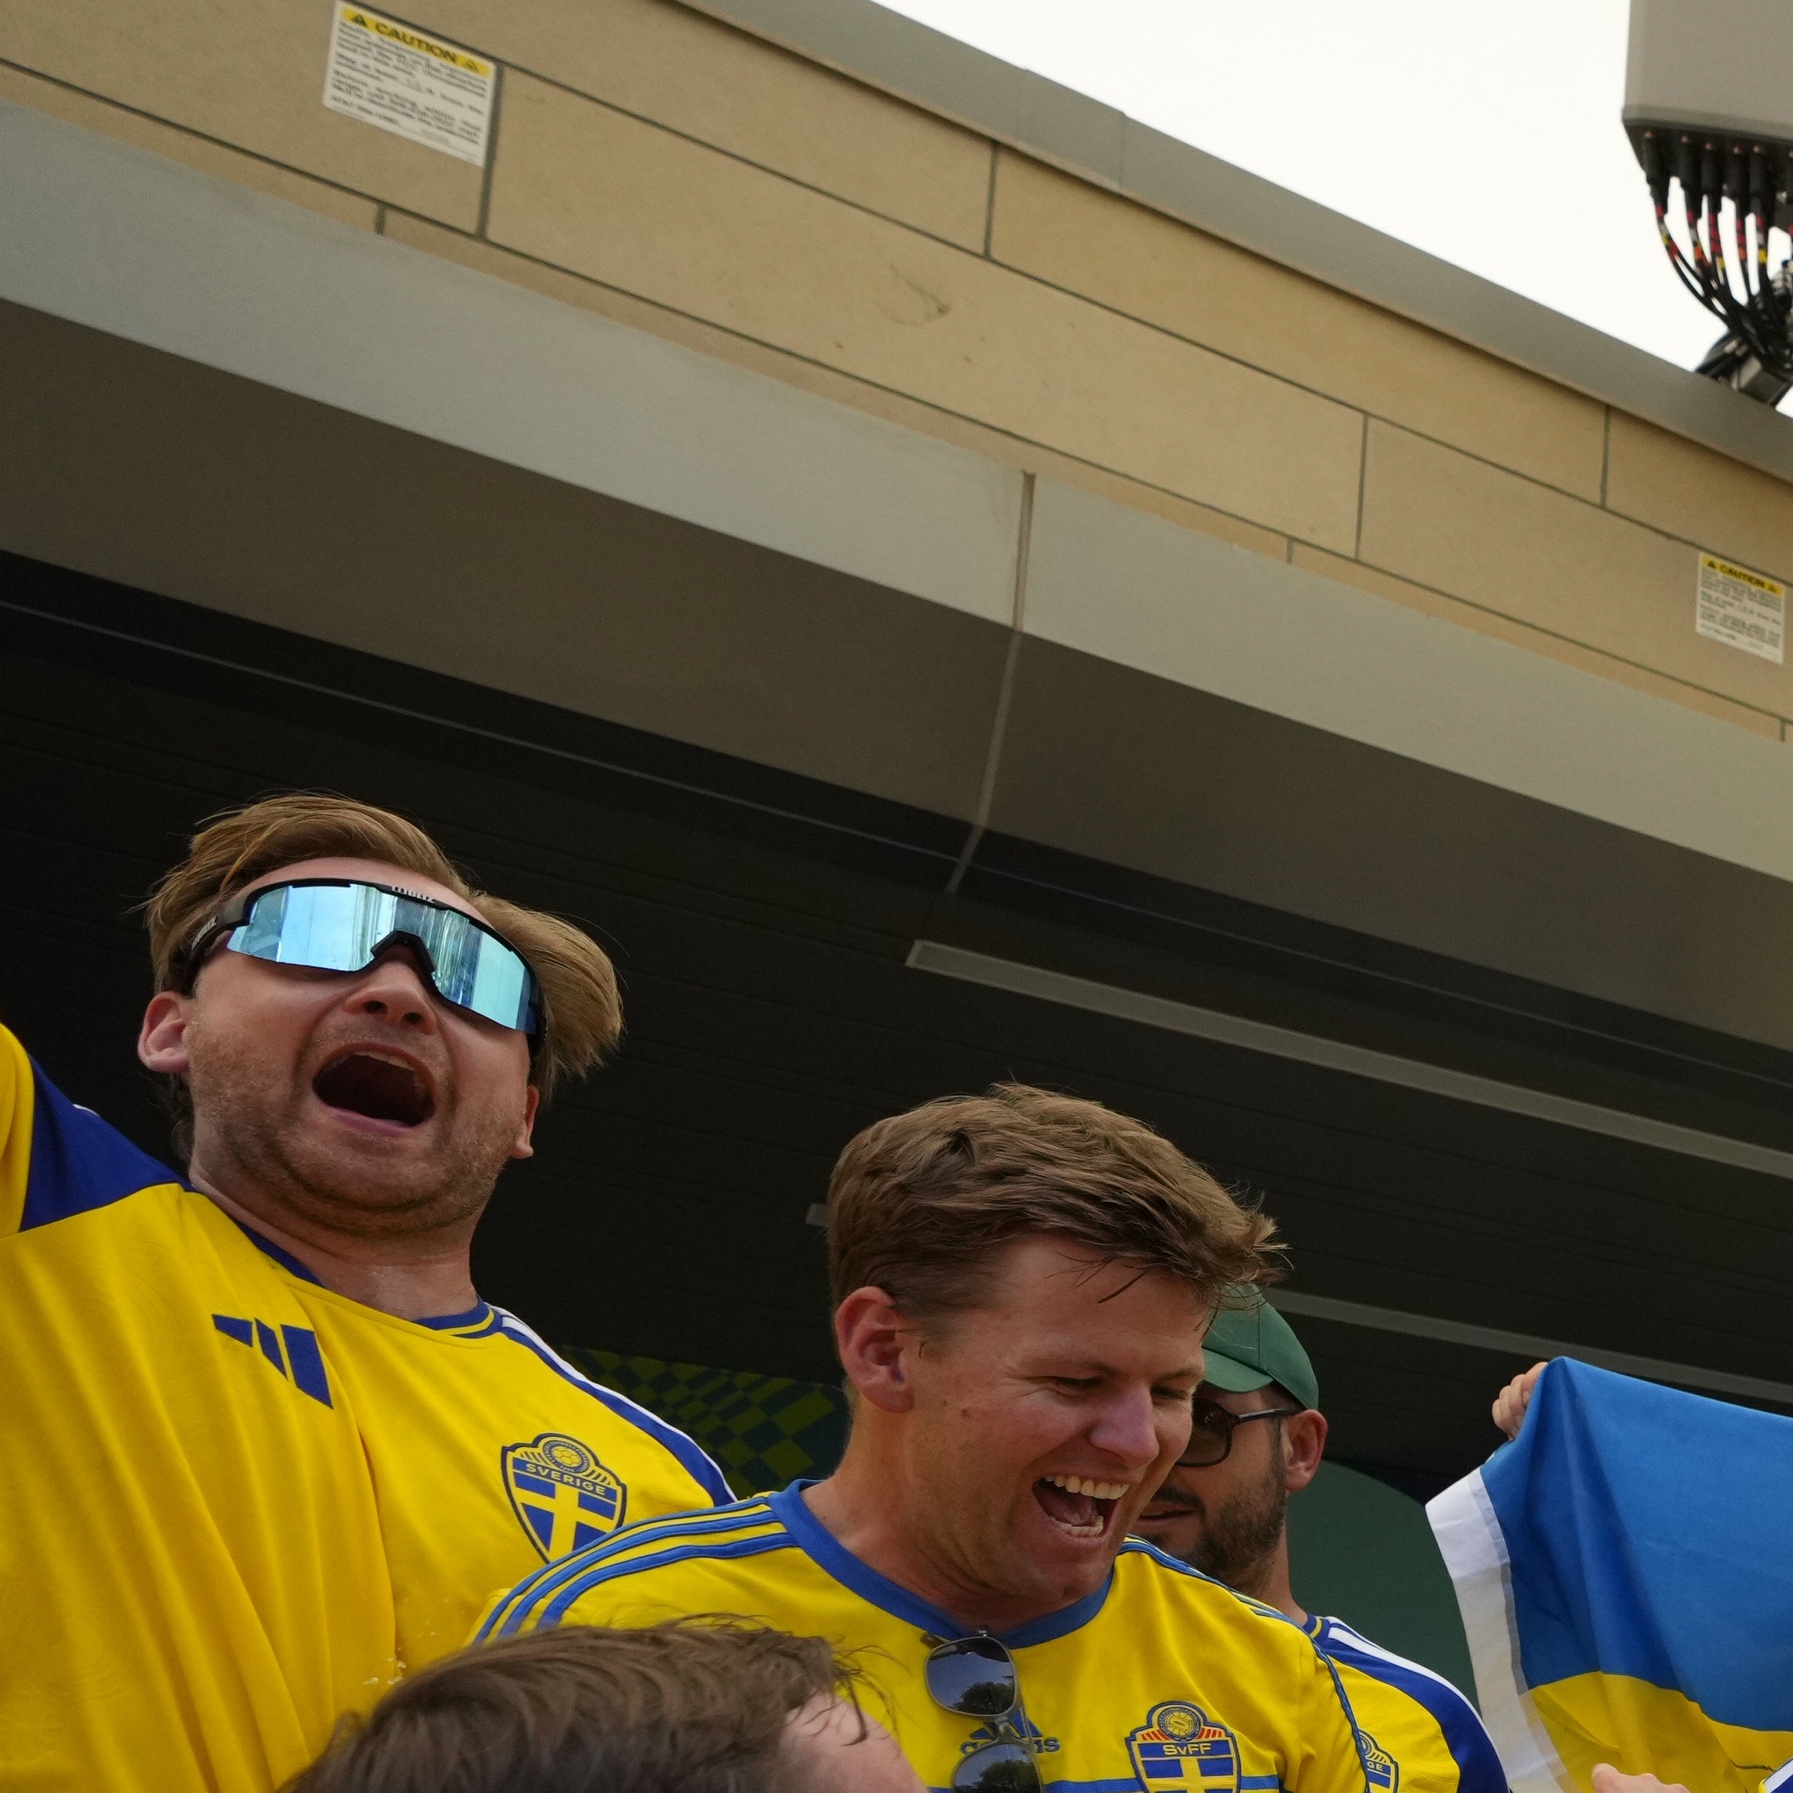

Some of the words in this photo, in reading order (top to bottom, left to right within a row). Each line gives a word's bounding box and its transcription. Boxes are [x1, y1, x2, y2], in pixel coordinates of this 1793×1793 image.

[375, 22, 457, 63] CAUTION
[525, 1463, 606, 1496] SVERIGE
[1163, 1743, 1212, 1755] SvFF
